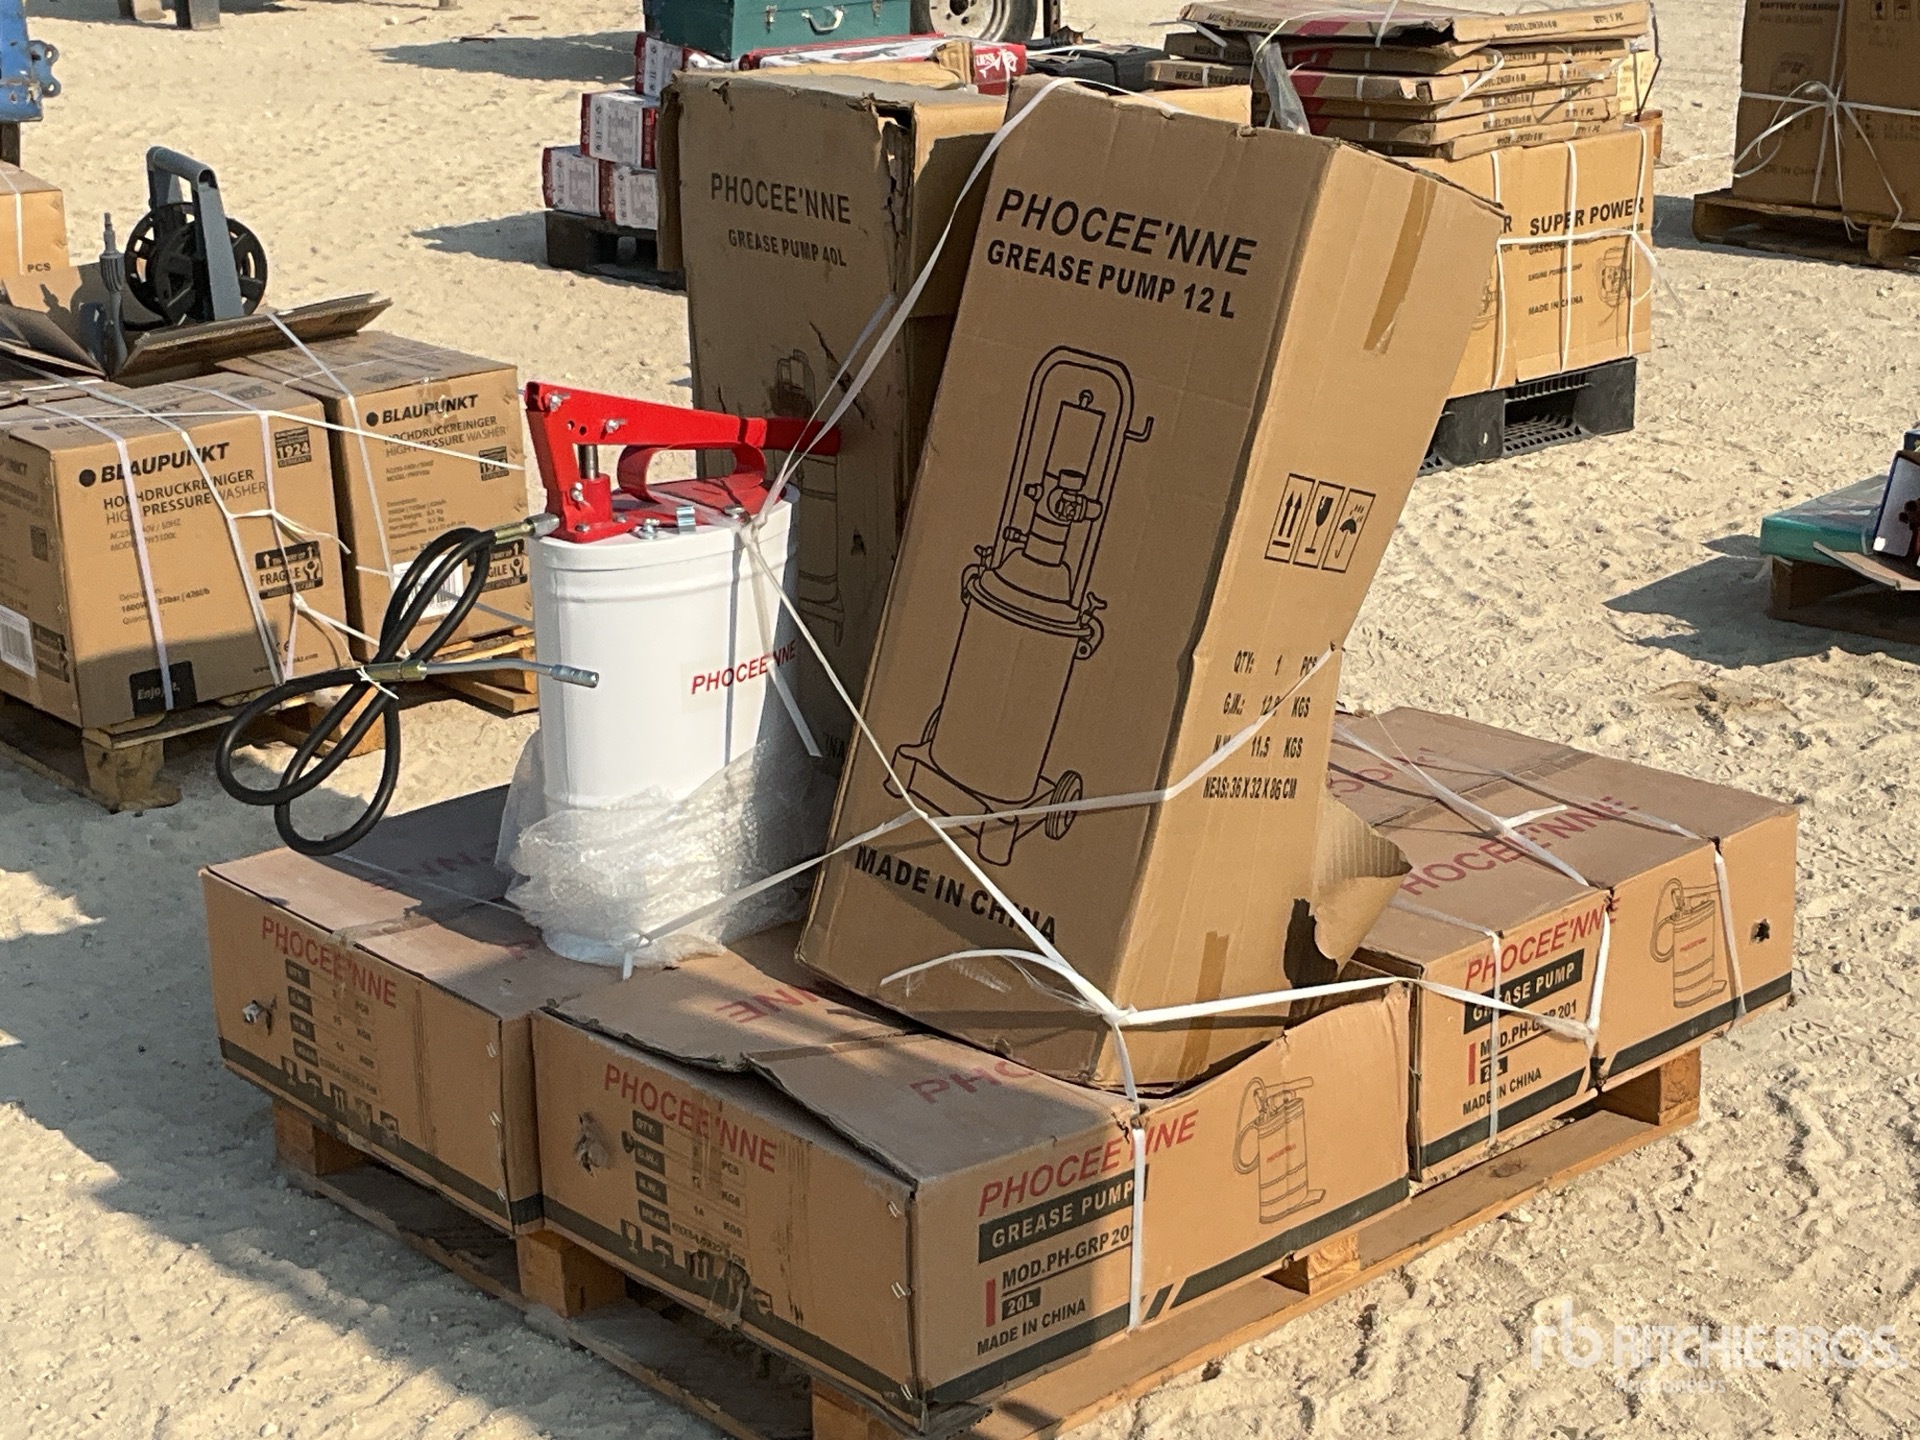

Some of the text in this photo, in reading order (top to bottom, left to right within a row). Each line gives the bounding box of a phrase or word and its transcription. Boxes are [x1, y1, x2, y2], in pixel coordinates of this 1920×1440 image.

[711, 172, 851, 225] PHOCEE'NNE
[728, 228, 779, 255] GREASE
[781, 237, 819, 262] PUMP
[996, 188, 1257, 276] PHOCEE'NNE
[27, 262, 51, 273] PCS
[987, 239, 1093, 286] GREASE
[1098, 263, 1175, 303] PUMP
[382, 394, 478, 424] BLAUPUNKT
[277, 442, 310, 460] 1924
[142, 493, 213, 517] PRESSURE
[1233, 649, 1254, 675] QTY:
[1274, 654, 1283, 676] 1
[1291, 697, 1311, 718] KGS
[1250, 736, 1271, 759] 11.5
[1283, 737, 1304, 759] KGS
[855, 844, 931, 894] MADE
[934, 875, 965, 908] IN
[1535, 962, 1576, 994] PUMP
[1463, 1090, 1492, 1115] MADE
[1509, 1067, 1542, 1093] CHINA
[604, 1063, 778, 1173] PHOCEE'NNE
[991, 1178, 1134, 1249] GREASE PUMP
[1007, 1294, 1034, 1315] 20L
[977, 1298, 1087, 1356] MADE IN CHINA
